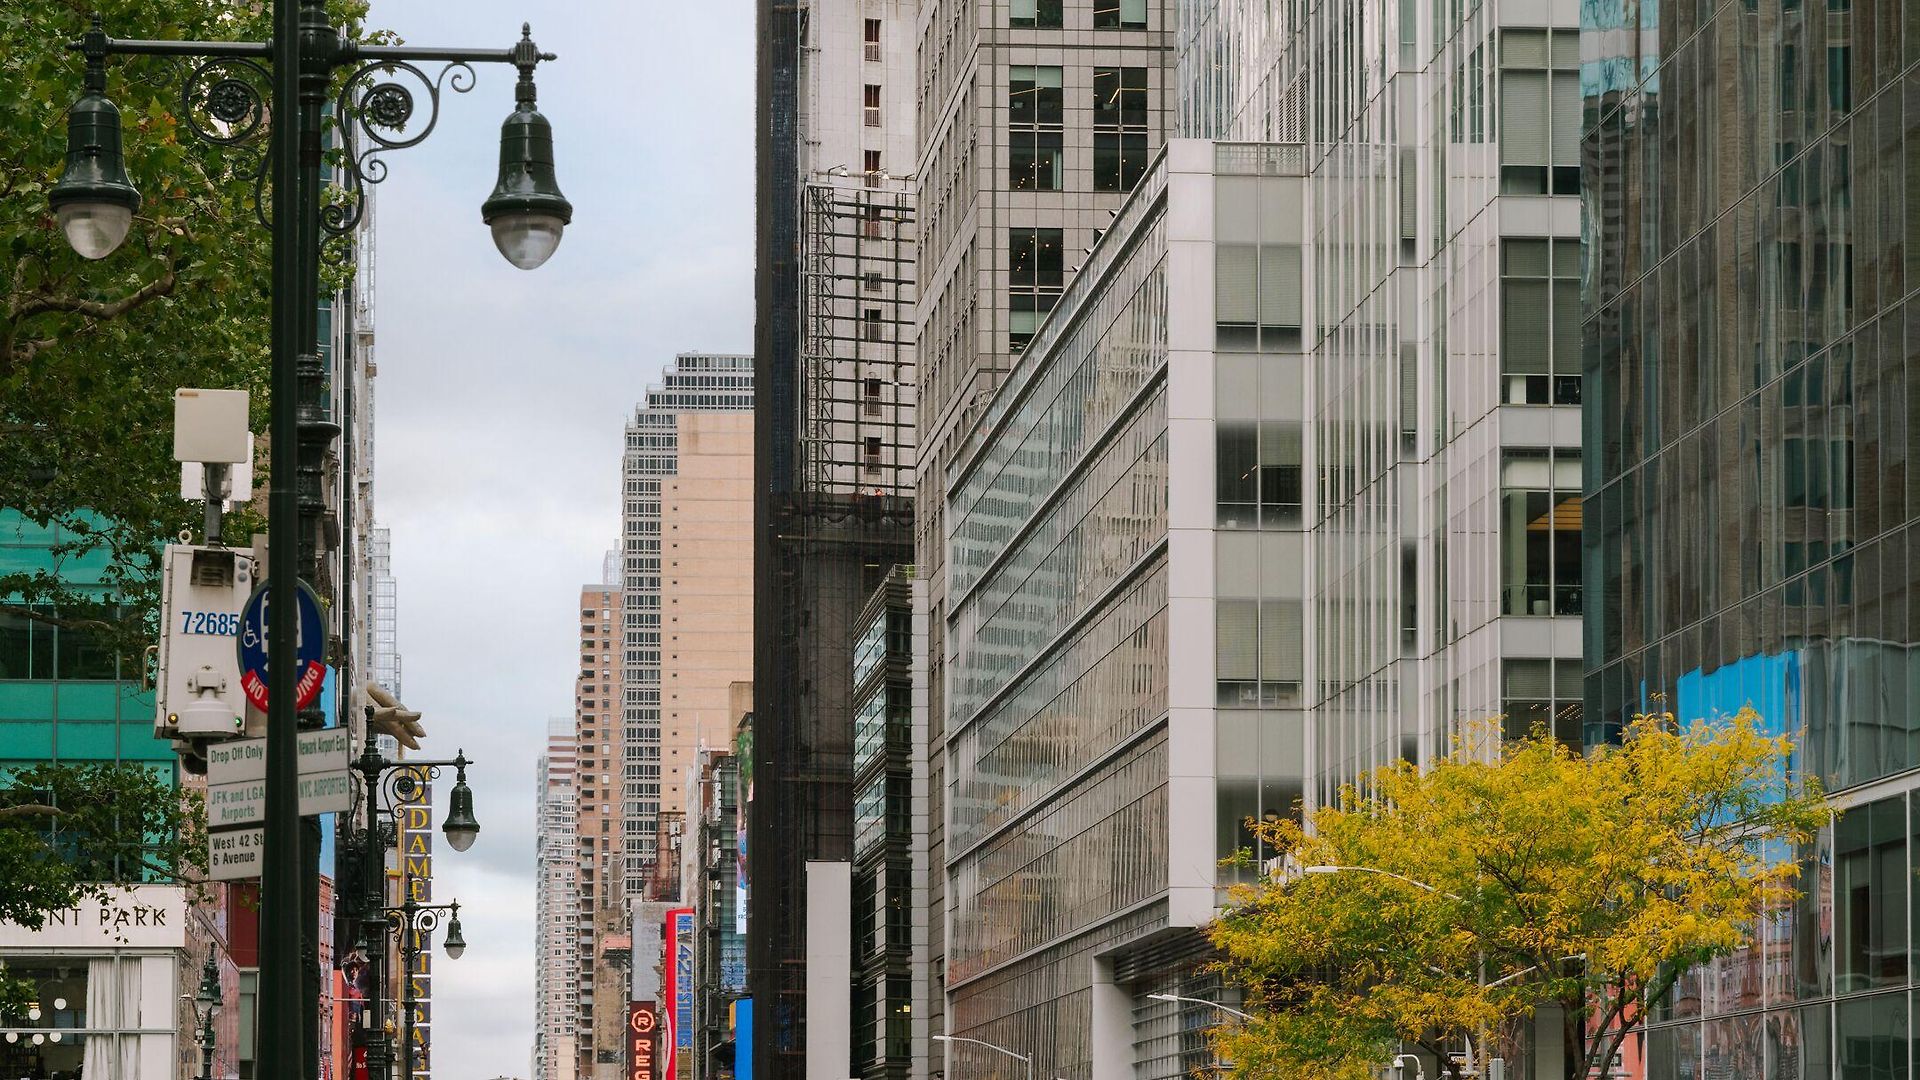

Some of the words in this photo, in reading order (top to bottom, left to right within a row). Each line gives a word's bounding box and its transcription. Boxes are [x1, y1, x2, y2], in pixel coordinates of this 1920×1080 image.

[247, 677, 264, 699] NO
[211, 750, 230, 764] Drop
[232, 747, 243, 760] Off
[245, 745, 264, 761] Only
[298, 739, 317, 756] Newark
[318, 736, 335, 757] Airport
[211, 790, 228, 805] JFK
[230, 788, 244, 802] and
[246, 785, 265, 800] LGA
[314, 776, 347, 798] AIRPORTER
[221, 805, 256, 822] Airports
[213, 836, 235, 850] West
[239, 835, 250, 847] 42
[213, 854, 219, 866] 6
[222, 851, 256, 865] Avenue
[99, 908, 166, 926] PARK
